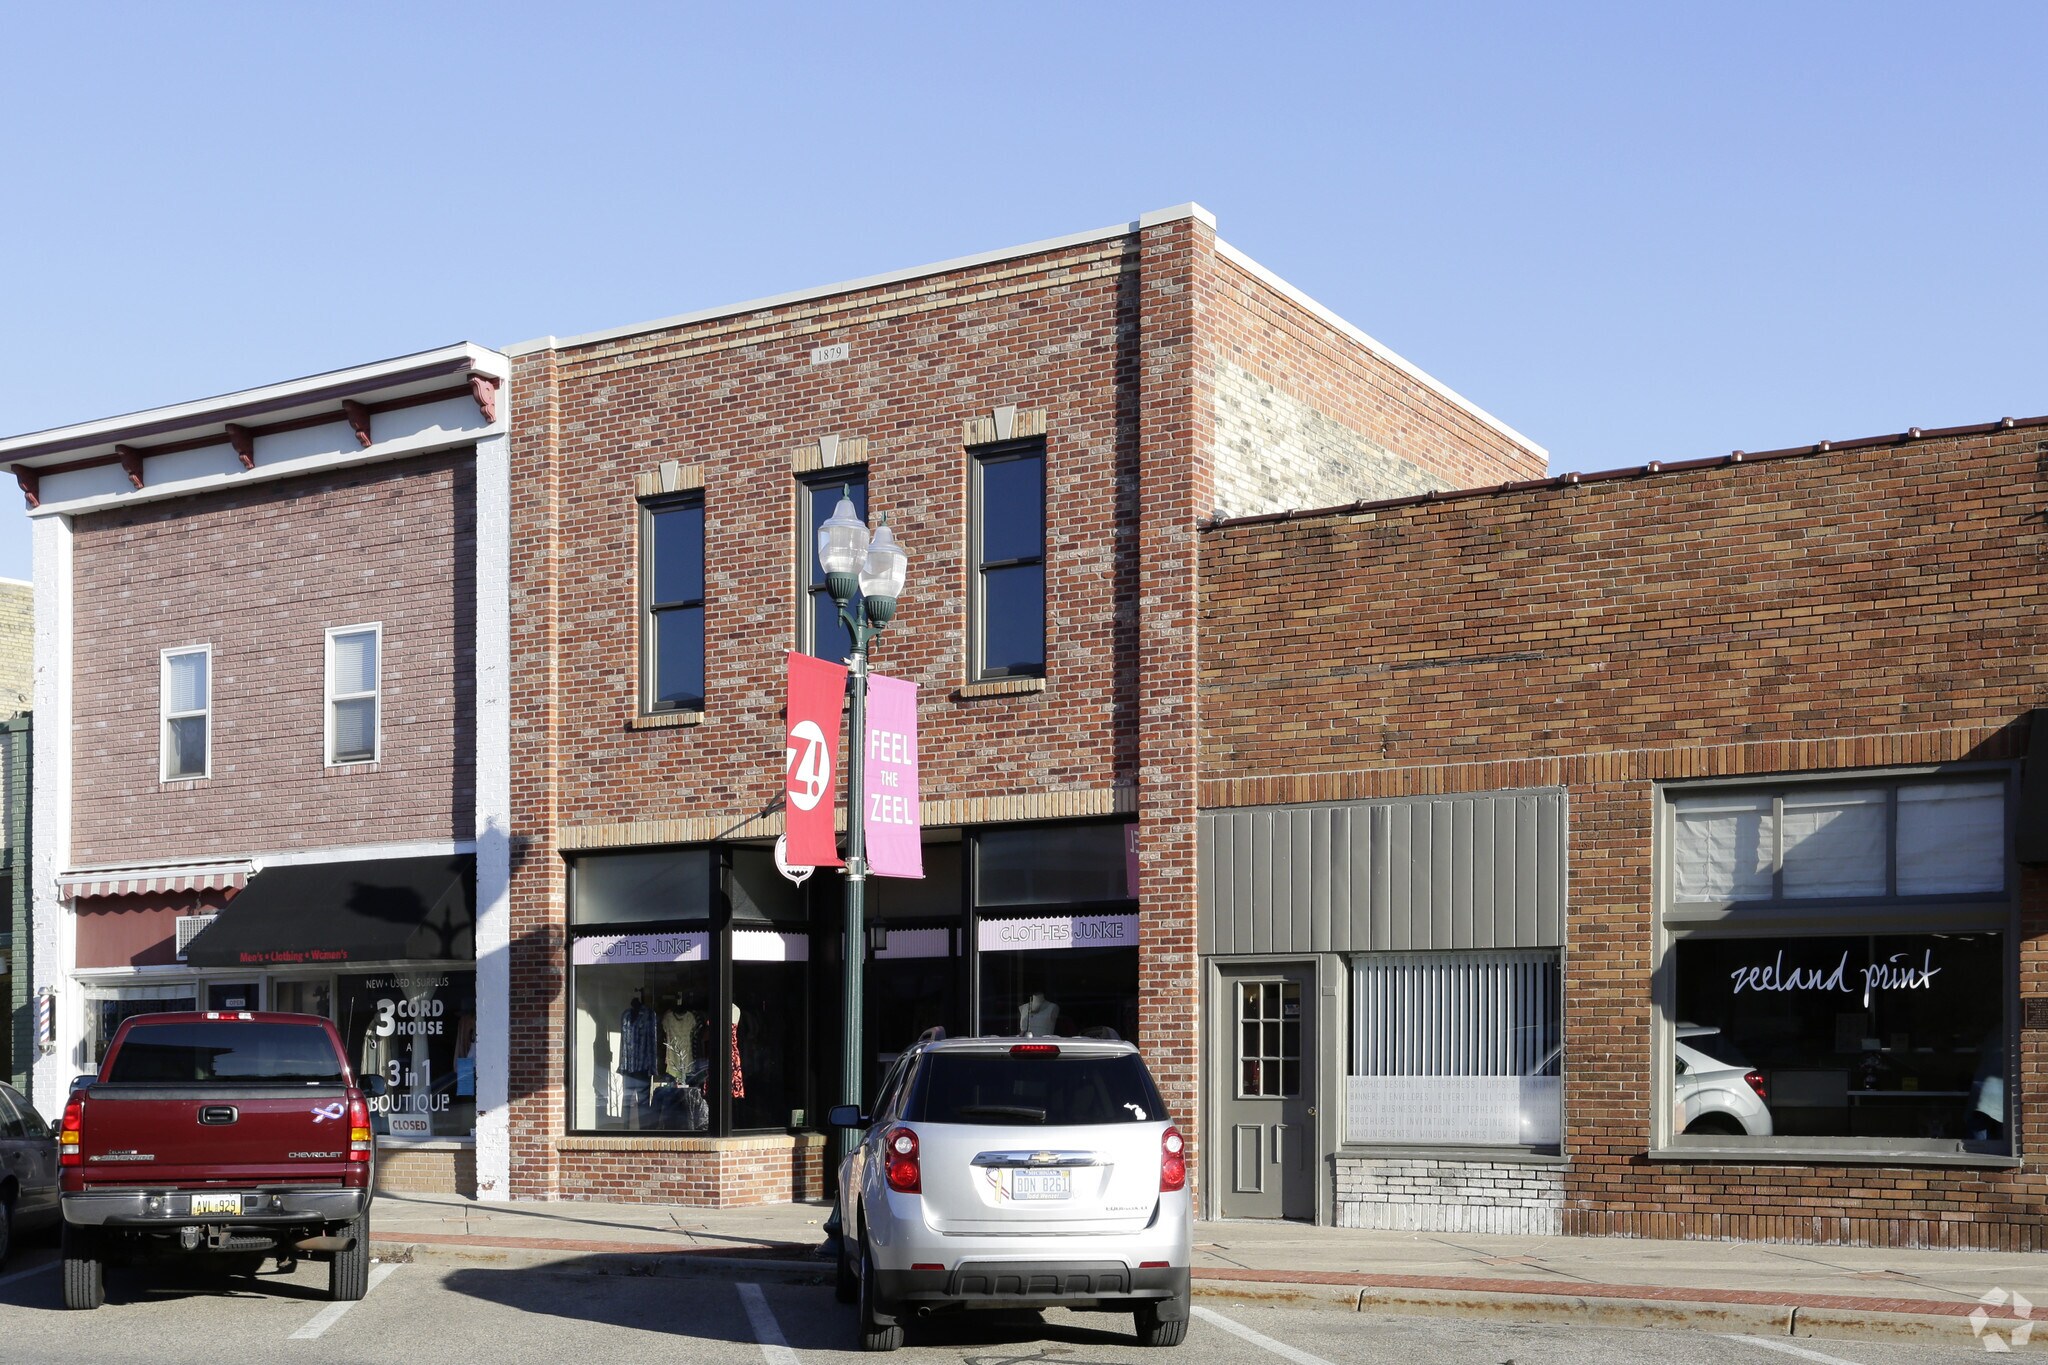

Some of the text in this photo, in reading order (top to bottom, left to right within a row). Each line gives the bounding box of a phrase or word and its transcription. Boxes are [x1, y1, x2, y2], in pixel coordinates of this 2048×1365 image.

[819, 346, 842, 361] 1879
[870, 729, 912, 765] FEEL
[880, 770, 899, 788] THE
[870, 793, 913, 825] ZEEL
[999, 921, 1124, 942] CLOTHES JUNKIE
[591, 938, 692, 958] CLOTHES JUNKIE
[240, 949, 348, 963] Men's Clothing Women's
[365, 977, 449, 989] NEW USED SURPLUS
[1730, 949, 1942, 1009] zeeland print
[376, 998, 444, 1037] 3 CORD
[397, 1021, 444, 1035] HOUSE
[405, 1042, 413, 1052] A
[388, 1059, 431, 1087] 3 in 1
[1384, 1080, 1411, 1089] DESIGN
[367, 1094, 450, 1114] BOUTIQUE
[1420, 1105, 1442, 1114] CARDS
[392, 1120, 428, 1131] CLOSED
[1017, 1177, 1067, 1192] BDN 8261
[219, 1200, 236, 1212] 929
